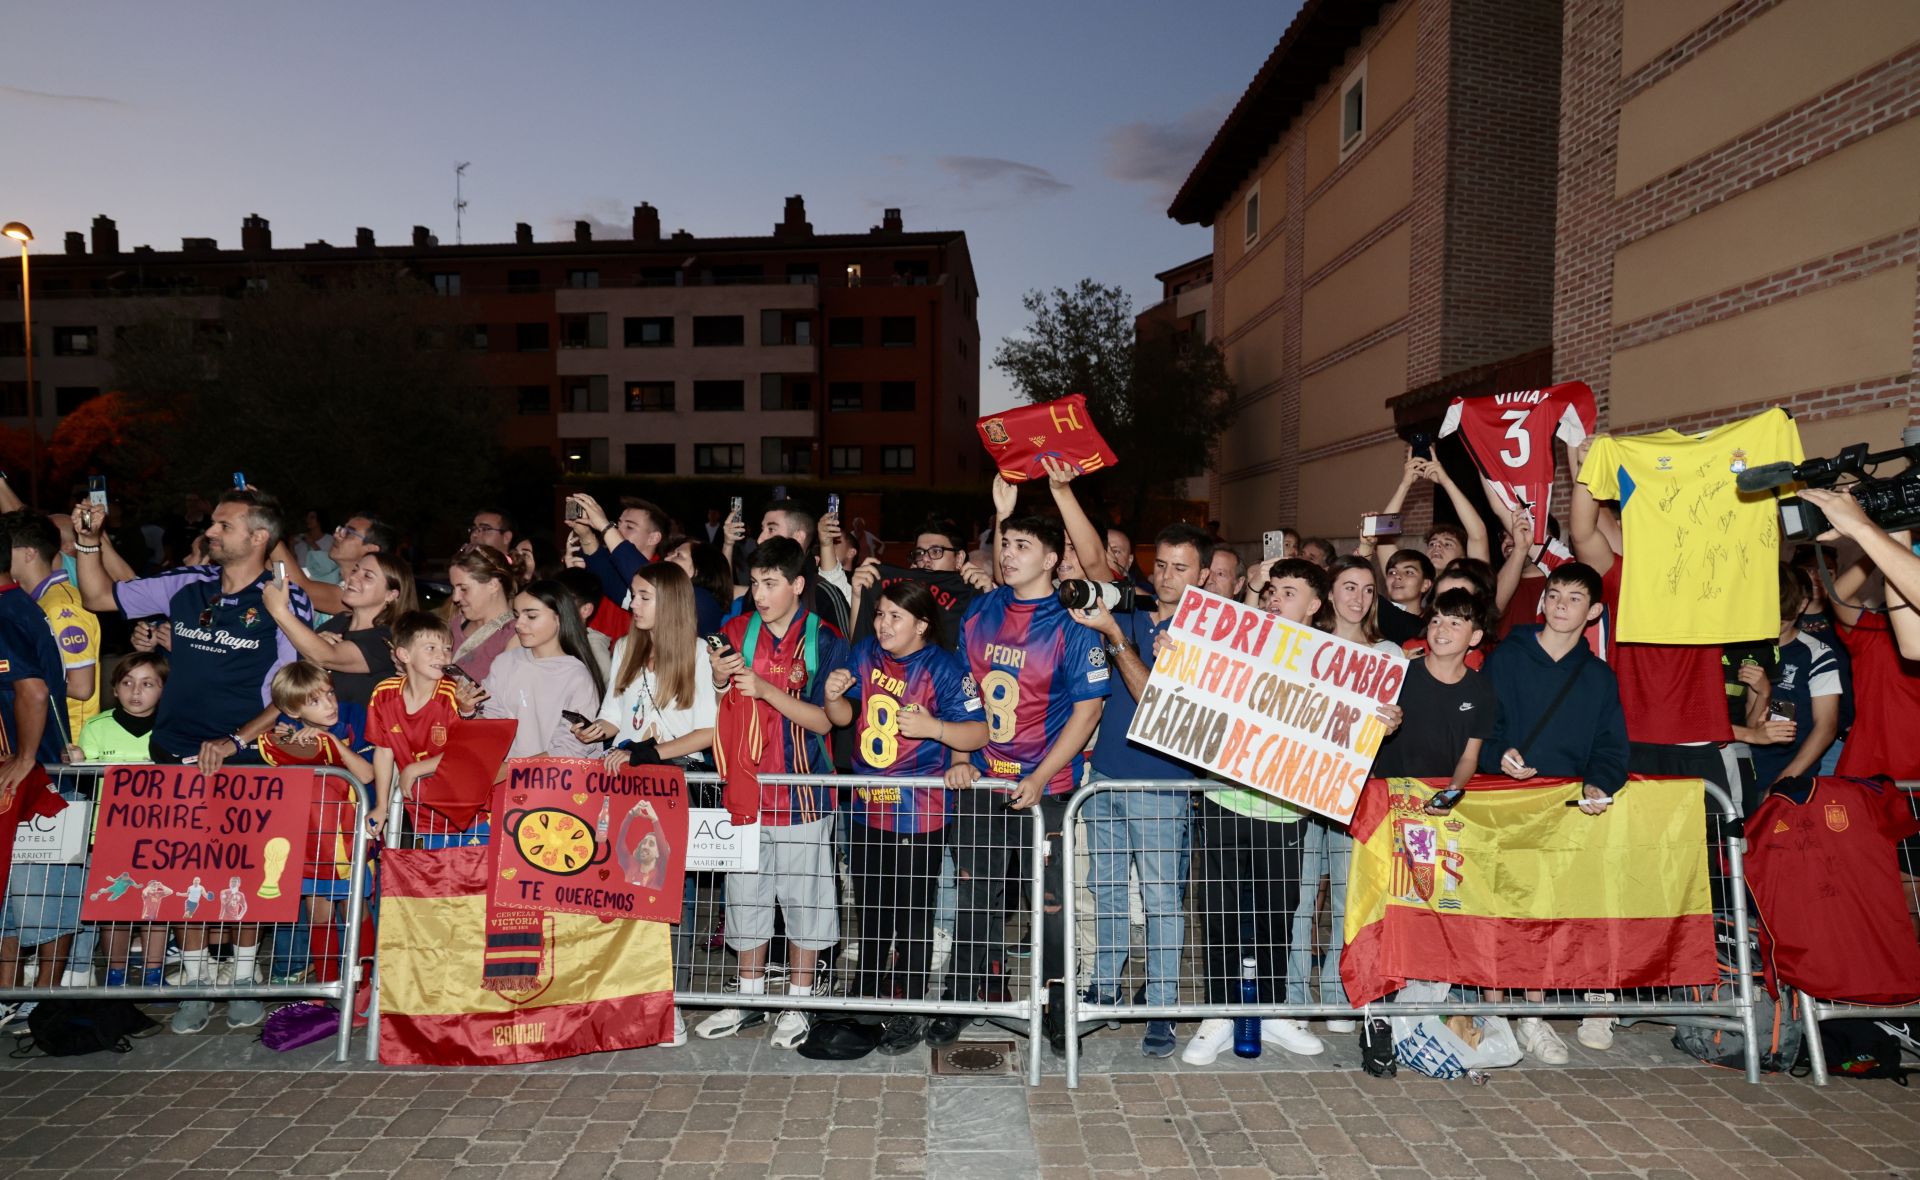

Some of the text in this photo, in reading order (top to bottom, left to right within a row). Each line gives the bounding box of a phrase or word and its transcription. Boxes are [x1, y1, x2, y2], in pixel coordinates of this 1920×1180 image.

[1500, 409, 1531, 468] 3
[62, 634, 86, 646] DIGI
[174, 621, 260, 650] Cuatro Rayas
[1173, 590, 1404, 704] PEDRI TE CAMBIO
[984, 643, 1027, 669] PEDRI
[871, 668, 908, 697] PEDRI
[980, 670, 1020, 743] 8
[1155, 639, 1387, 760] UNA FOTO CONTIGO POR UN
[860, 693, 900, 769] 8
[1128, 684, 1367, 817] PLÁTANO DE CANARIAS
[112, 768, 284, 800] POR LA ROJA
[510, 767, 680, 798] MARC CUCURELLA
[106, 801, 272, 834] MORIRÉ, SOY
[694, 820, 735, 840] AC
[131, 838, 255, 870] ESPAÑOL
[518, 880, 635, 912] TE QUEREMOS
[491, 917, 539, 927] VICTORIA
